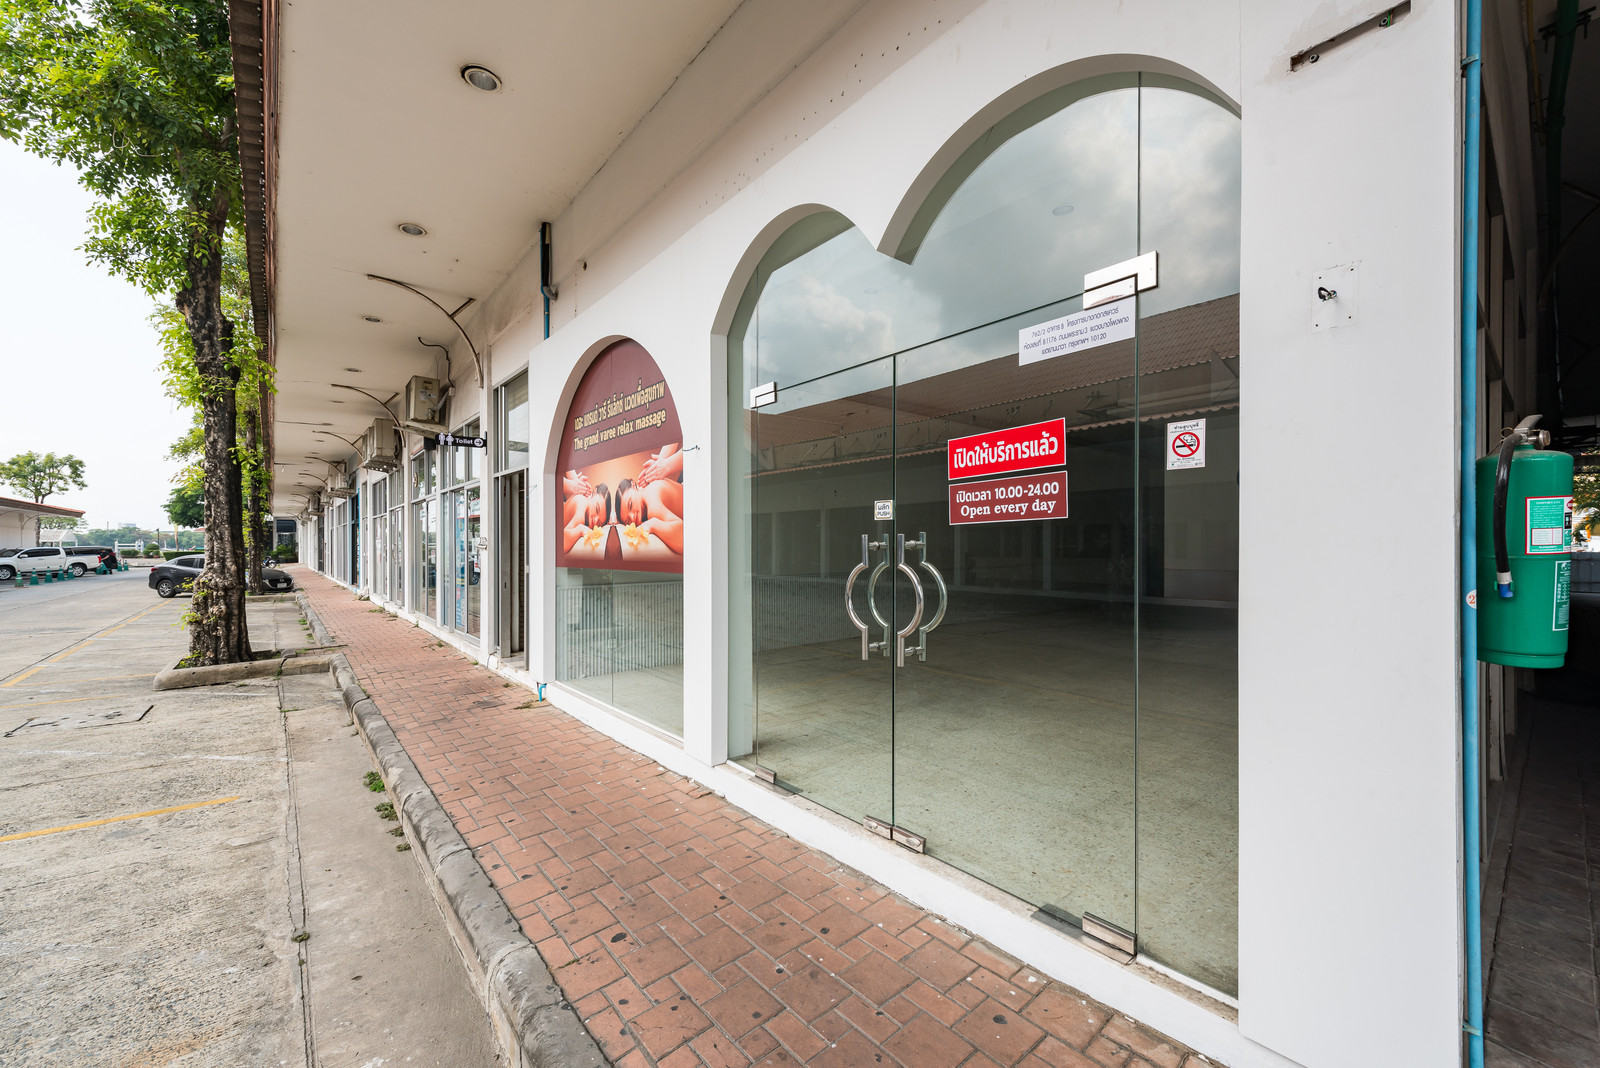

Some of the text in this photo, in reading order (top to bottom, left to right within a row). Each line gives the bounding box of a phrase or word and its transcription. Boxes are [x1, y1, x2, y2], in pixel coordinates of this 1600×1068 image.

[1091, 332, 1107, 342] 10120
[574, 409, 666, 451] The grand varee relax massage
[954, 431, 1059, 469] เปิดให้บริการแล้ว
[956, 481, 1060, 503] เปิดเวลา 10.00-24.00
[960, 499, 1057, 519] Open every day
